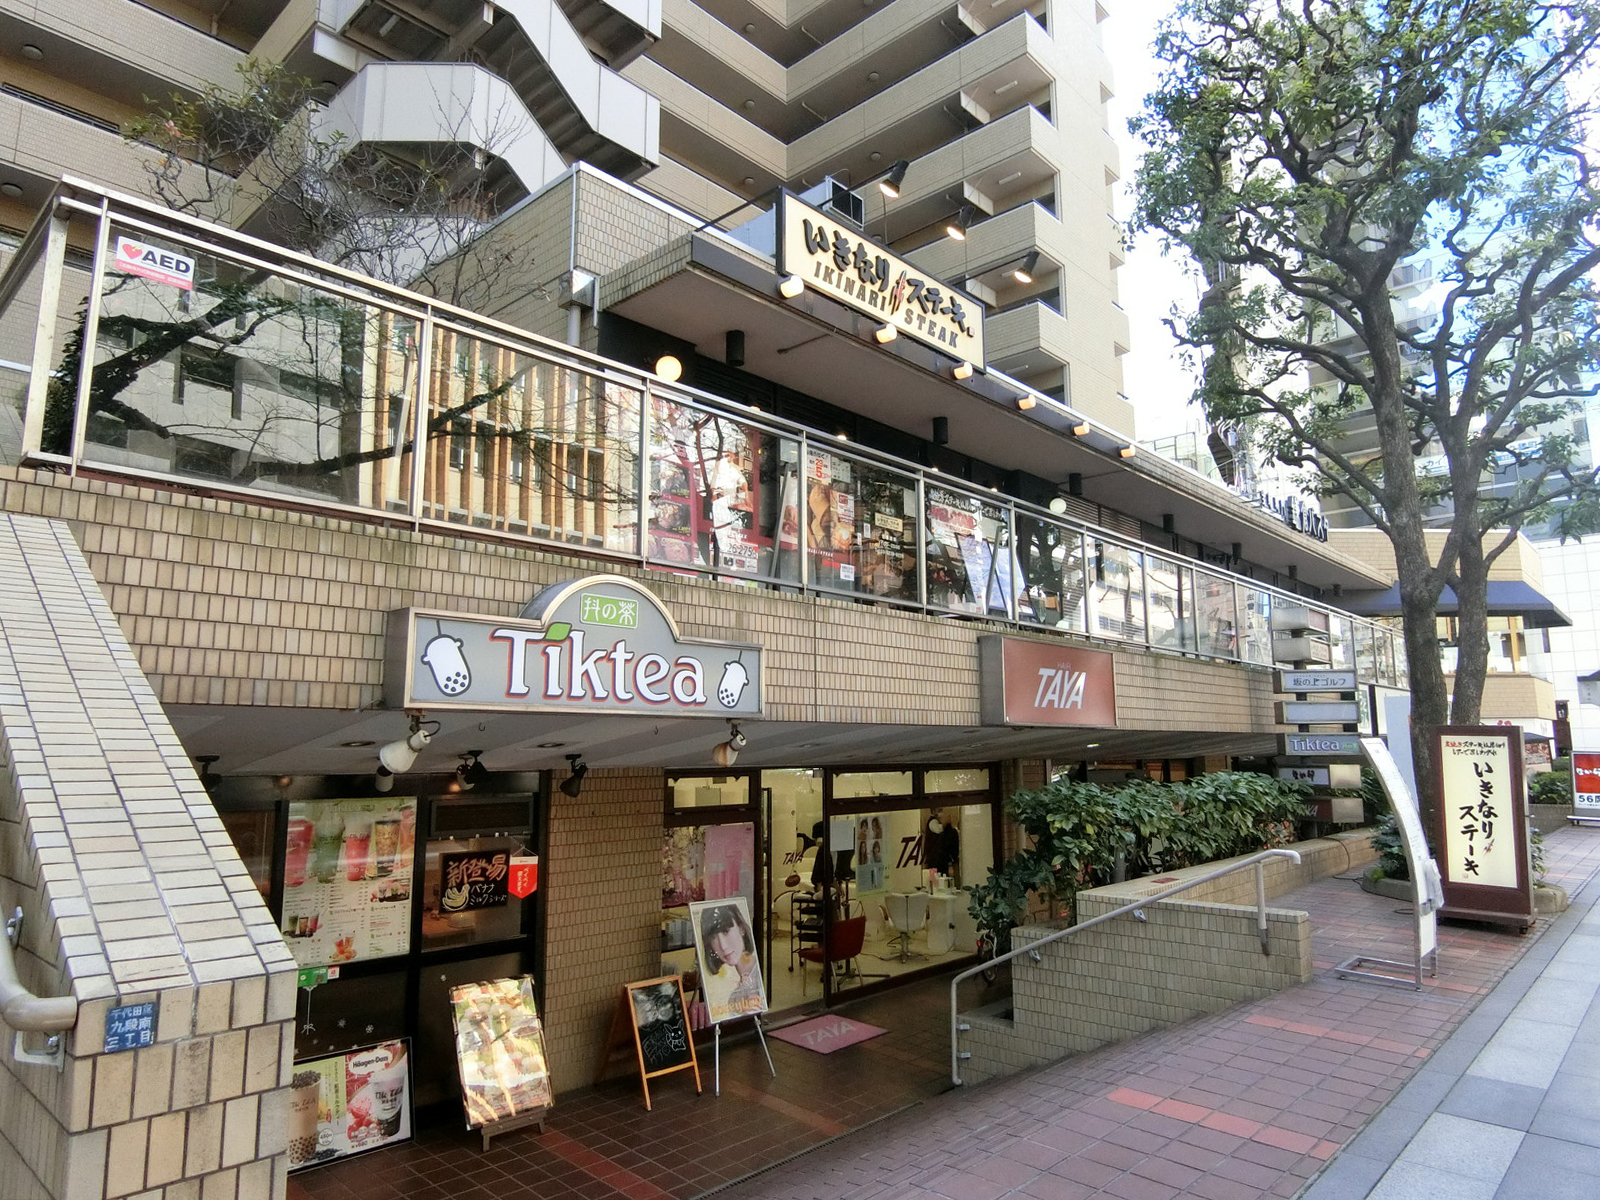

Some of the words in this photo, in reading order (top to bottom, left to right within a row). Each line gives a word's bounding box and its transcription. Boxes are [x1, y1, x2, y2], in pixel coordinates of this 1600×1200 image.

[142, 250, 191, 273] AED
[803, 218, 890, 292] いきなり
[907, 279, 966, 332] ステーキ
[814, 261, 887, 312] IKINARI
[904, 308, 959, 349] STEAK
[584, 597, 635, 626] 抖の茶
[490, 623, 708, 707] Tiktea
[1034, 667, 1087, 709] TAYA
[1292, 677, 1346, 687] 坂の上ゴルフ
[1290, 736, 1340, 751] Tiktea
[1473, 762, 1499, 839] いきなり
[1459, 805, 1479, 876] ステーキ
[446, 853, 508, 888] 新登場
[782, 851, 804, 865] TAYA
[470, 883, 495, 894] バナナ
[110, 1003, 153, 1019] 千代田区
[110, 1016, 152, 1034] 九段南
[801, 1020, 857, 1045] TAYA
[107, 1029, 150, 1048] 三丁目
